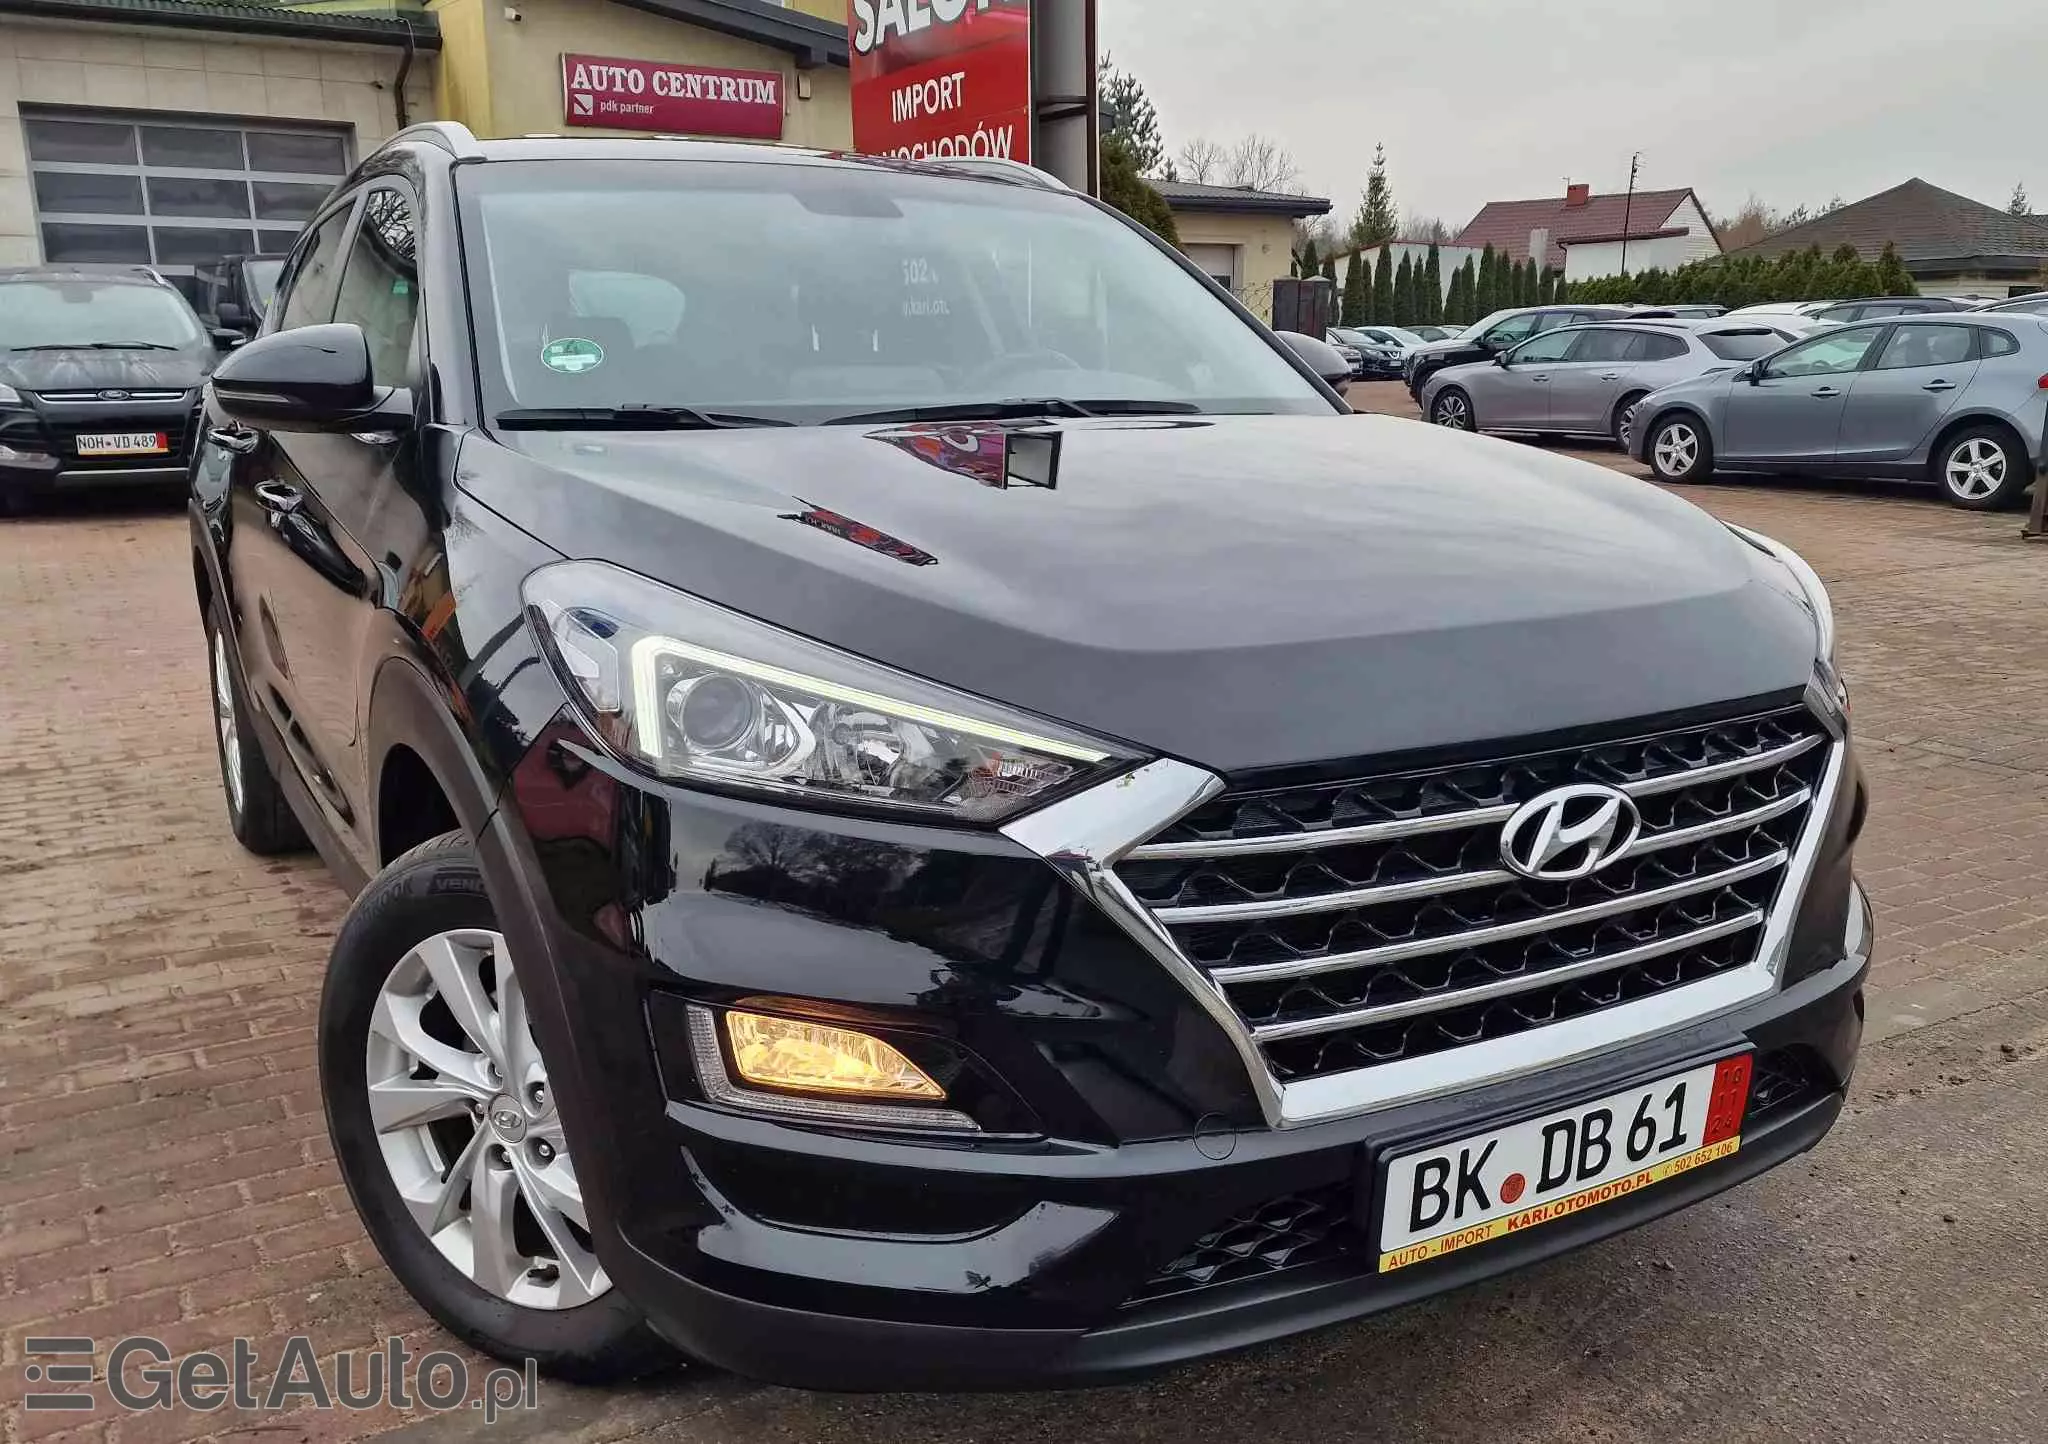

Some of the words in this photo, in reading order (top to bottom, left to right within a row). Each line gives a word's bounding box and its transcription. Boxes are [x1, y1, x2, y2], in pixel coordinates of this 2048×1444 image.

[571, 63, 645, 94] AUTO
[652, 70, 776, 105] CENTRUM
[892, 72, 965, 123] IMPORT
[600, 100, 618, 113] pdk
[620, 102, 654, 115] partner
[77, 436, 104, 449] NOH
[113, 436, 131, 448] VD
[133, 435, 156, 448] 489
[1409, 1139, 1498, 1233] BK
[1535, 1109, 1613, 1194] DB
[1626, 1082, 1687, 1162] 61
[1388, 1245, 1428, 1269] AUTO
[1440, 1225, 1493, 1252] IMPORT
[1507, 1170, 1653, 1231] KARI.OTOMOTO.PL
[1674, 1158, 1692, 1173] 502
[1694, 1149, 1713, 1168] 652
[1716, 1141, 1733, 1158] 106
